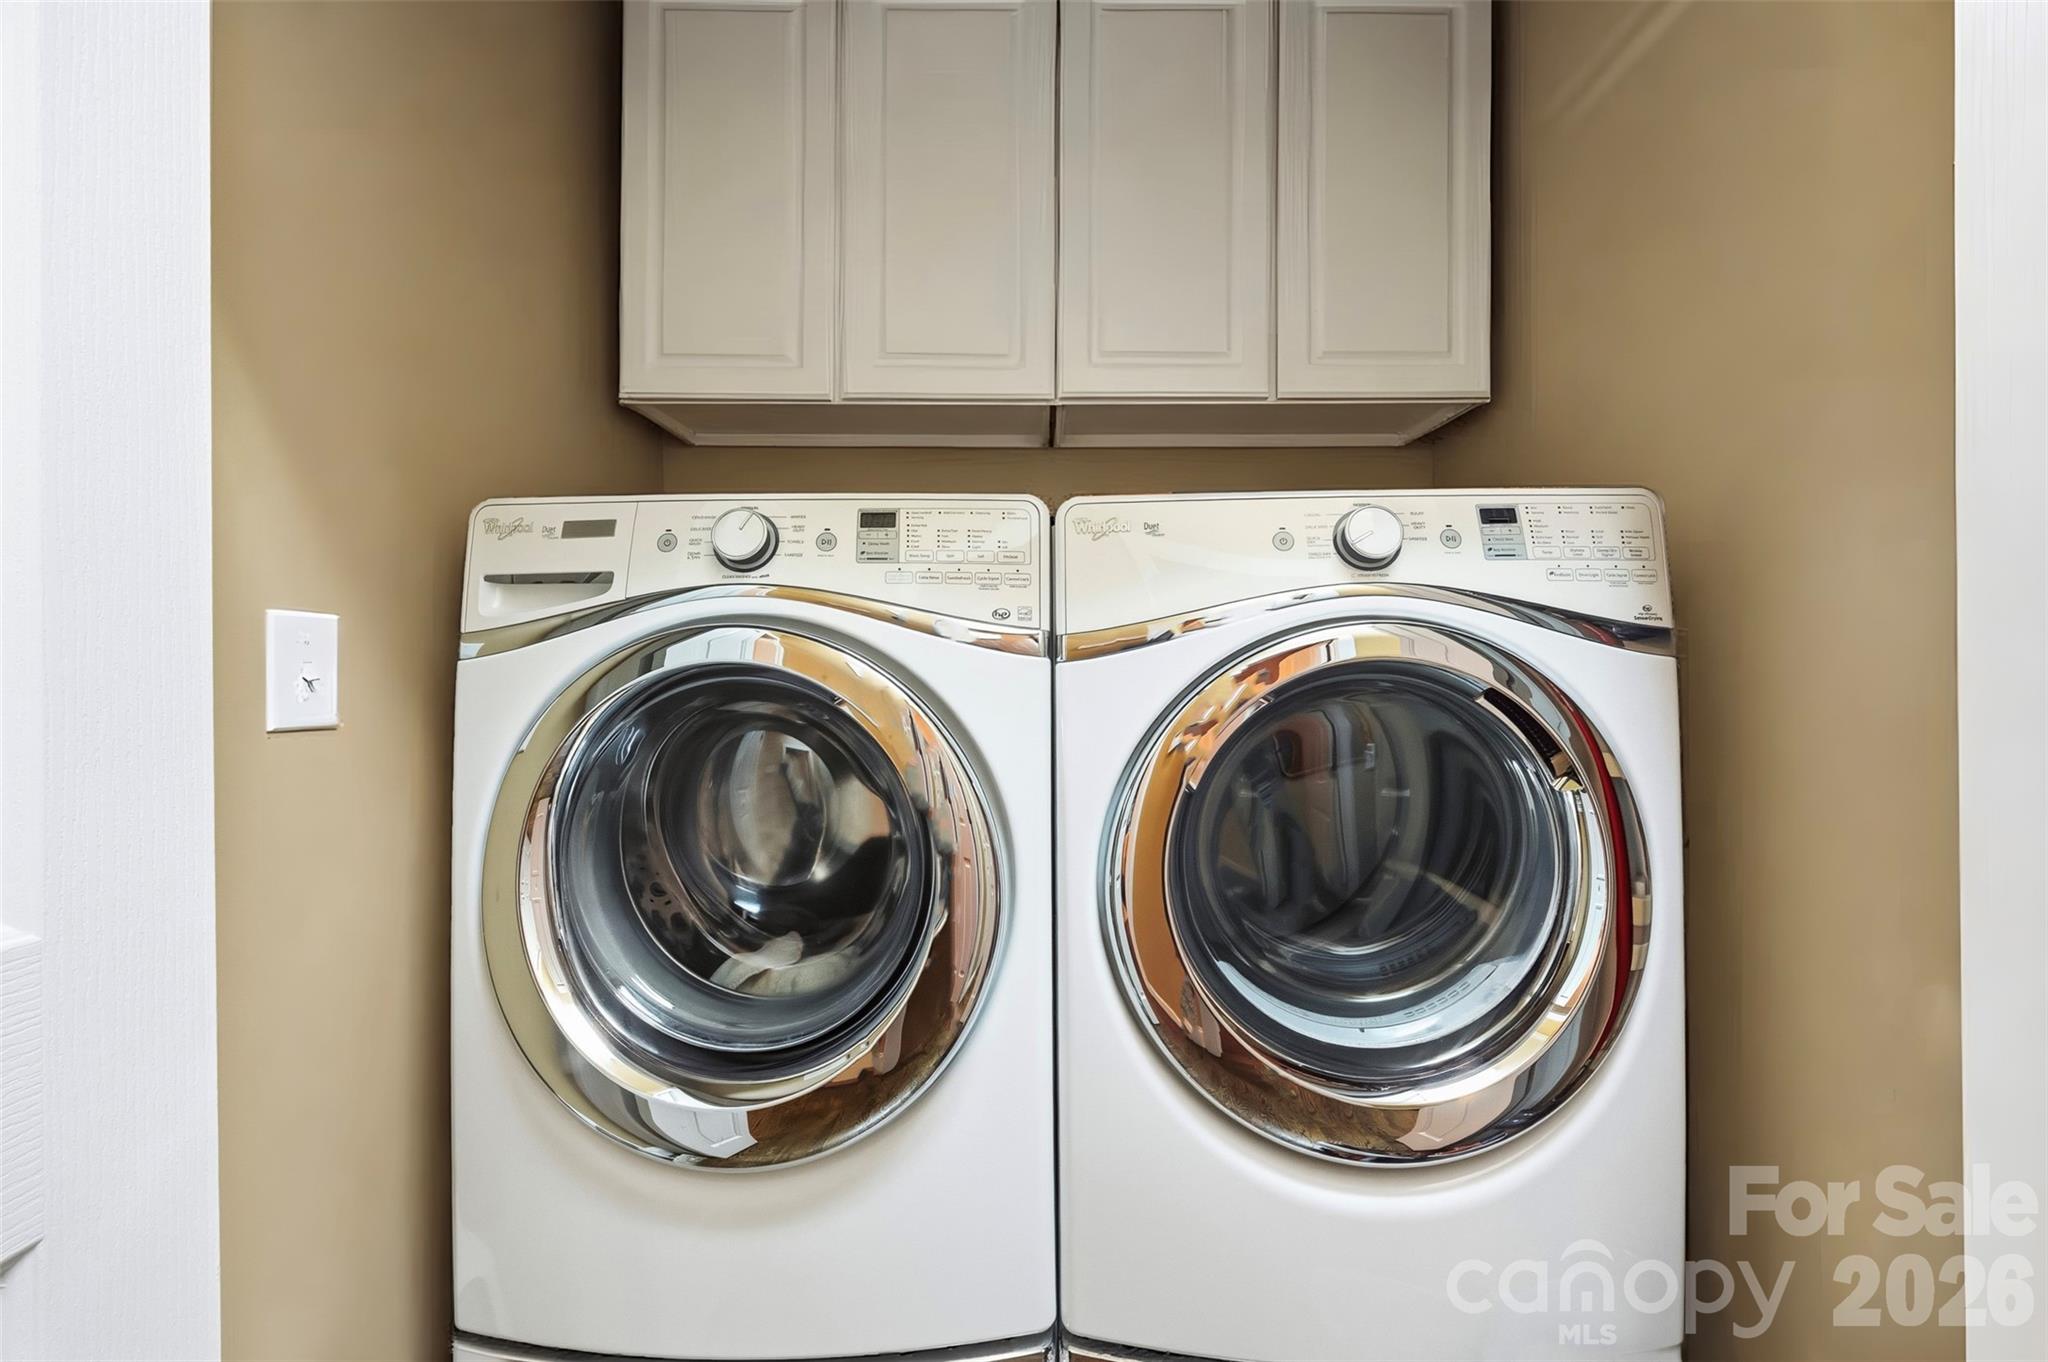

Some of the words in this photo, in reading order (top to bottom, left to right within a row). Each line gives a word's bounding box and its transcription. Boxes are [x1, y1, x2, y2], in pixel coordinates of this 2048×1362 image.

[483, 517, 534, 541] Whirlpool
[1072, 517, 1132, 541] Whirlpool
[1143, 522, 1160, 531] Duet
